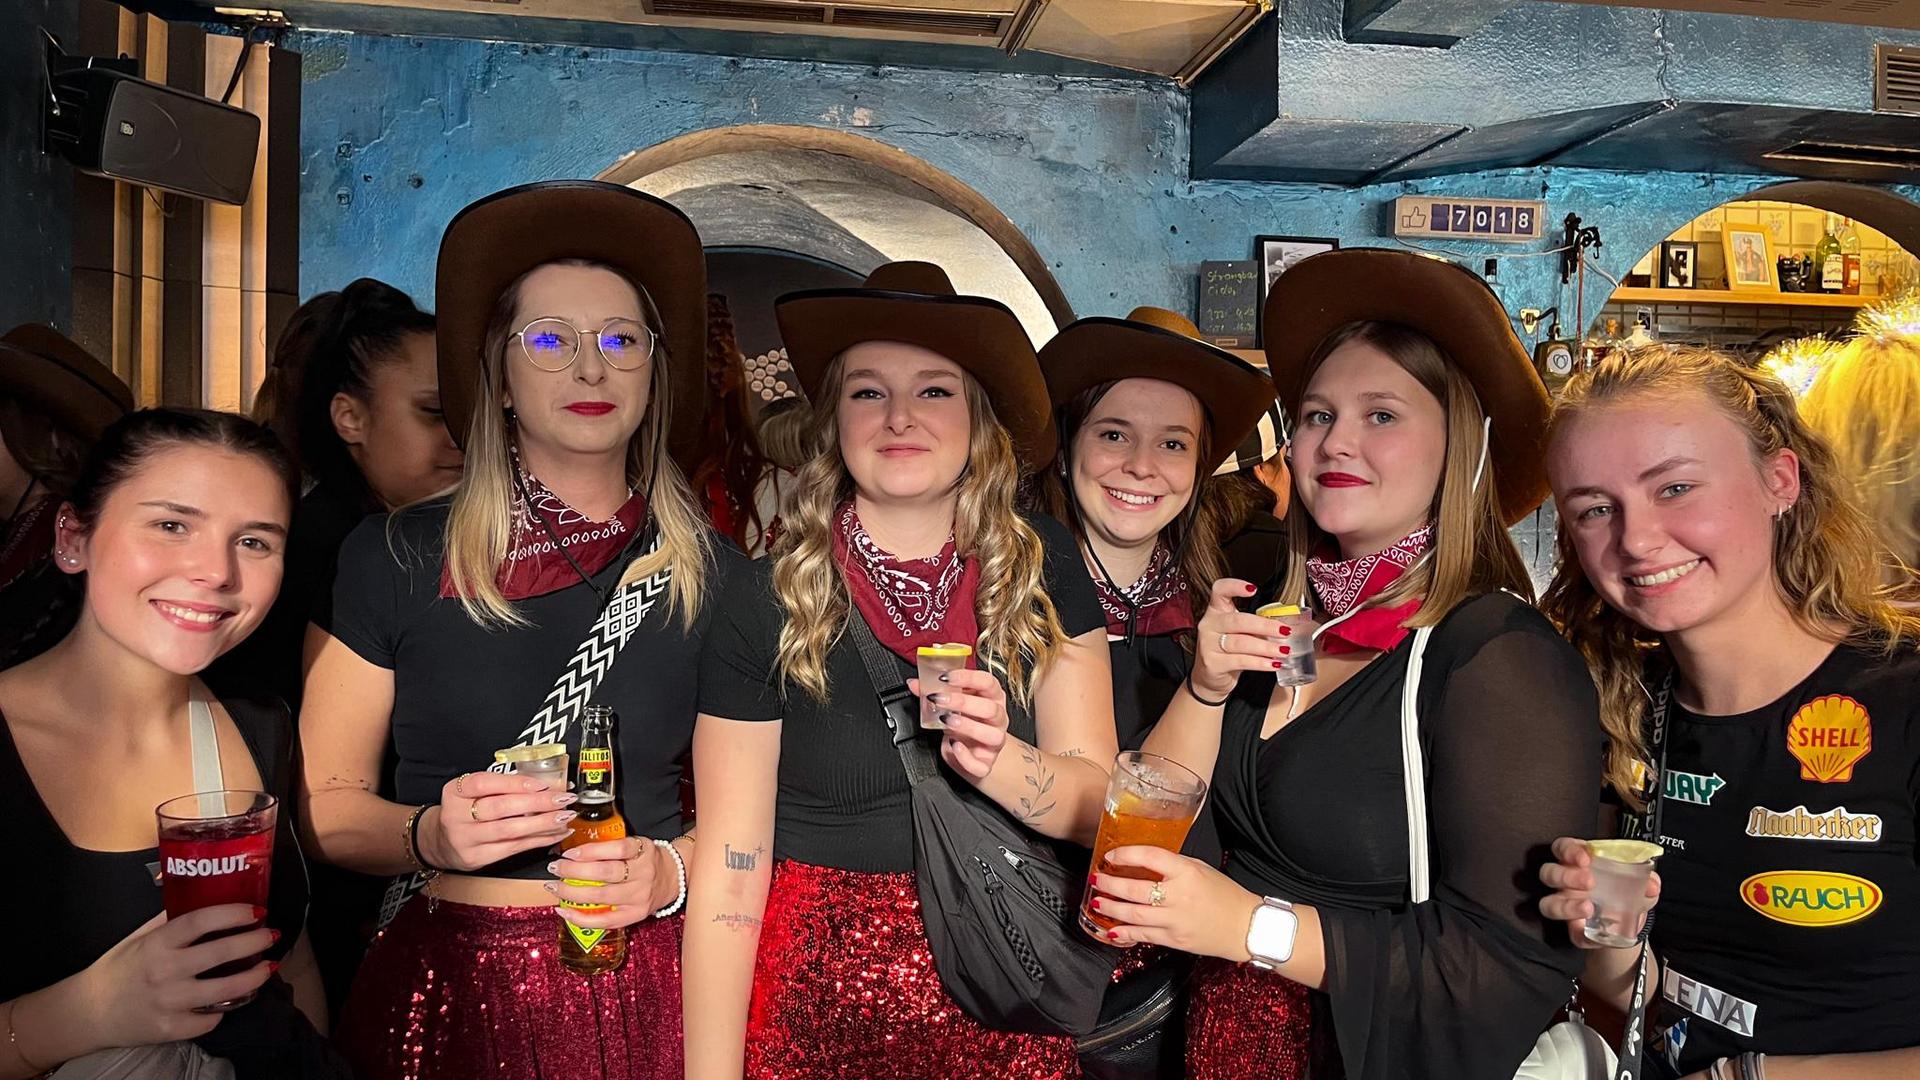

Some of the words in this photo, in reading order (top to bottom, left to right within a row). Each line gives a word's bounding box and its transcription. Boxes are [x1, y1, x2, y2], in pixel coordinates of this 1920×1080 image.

[1455, 209, 1529, 229] 7018
[1797, 727, 1861, 748] SHELL
[1749, 807, 1880, 841] Naabecker
[166, 853, 251, 877] ABSOLUT.
[1771, 885, 1866, 911] RAUCH
[1663, 968, 1752, 1036] LENA
